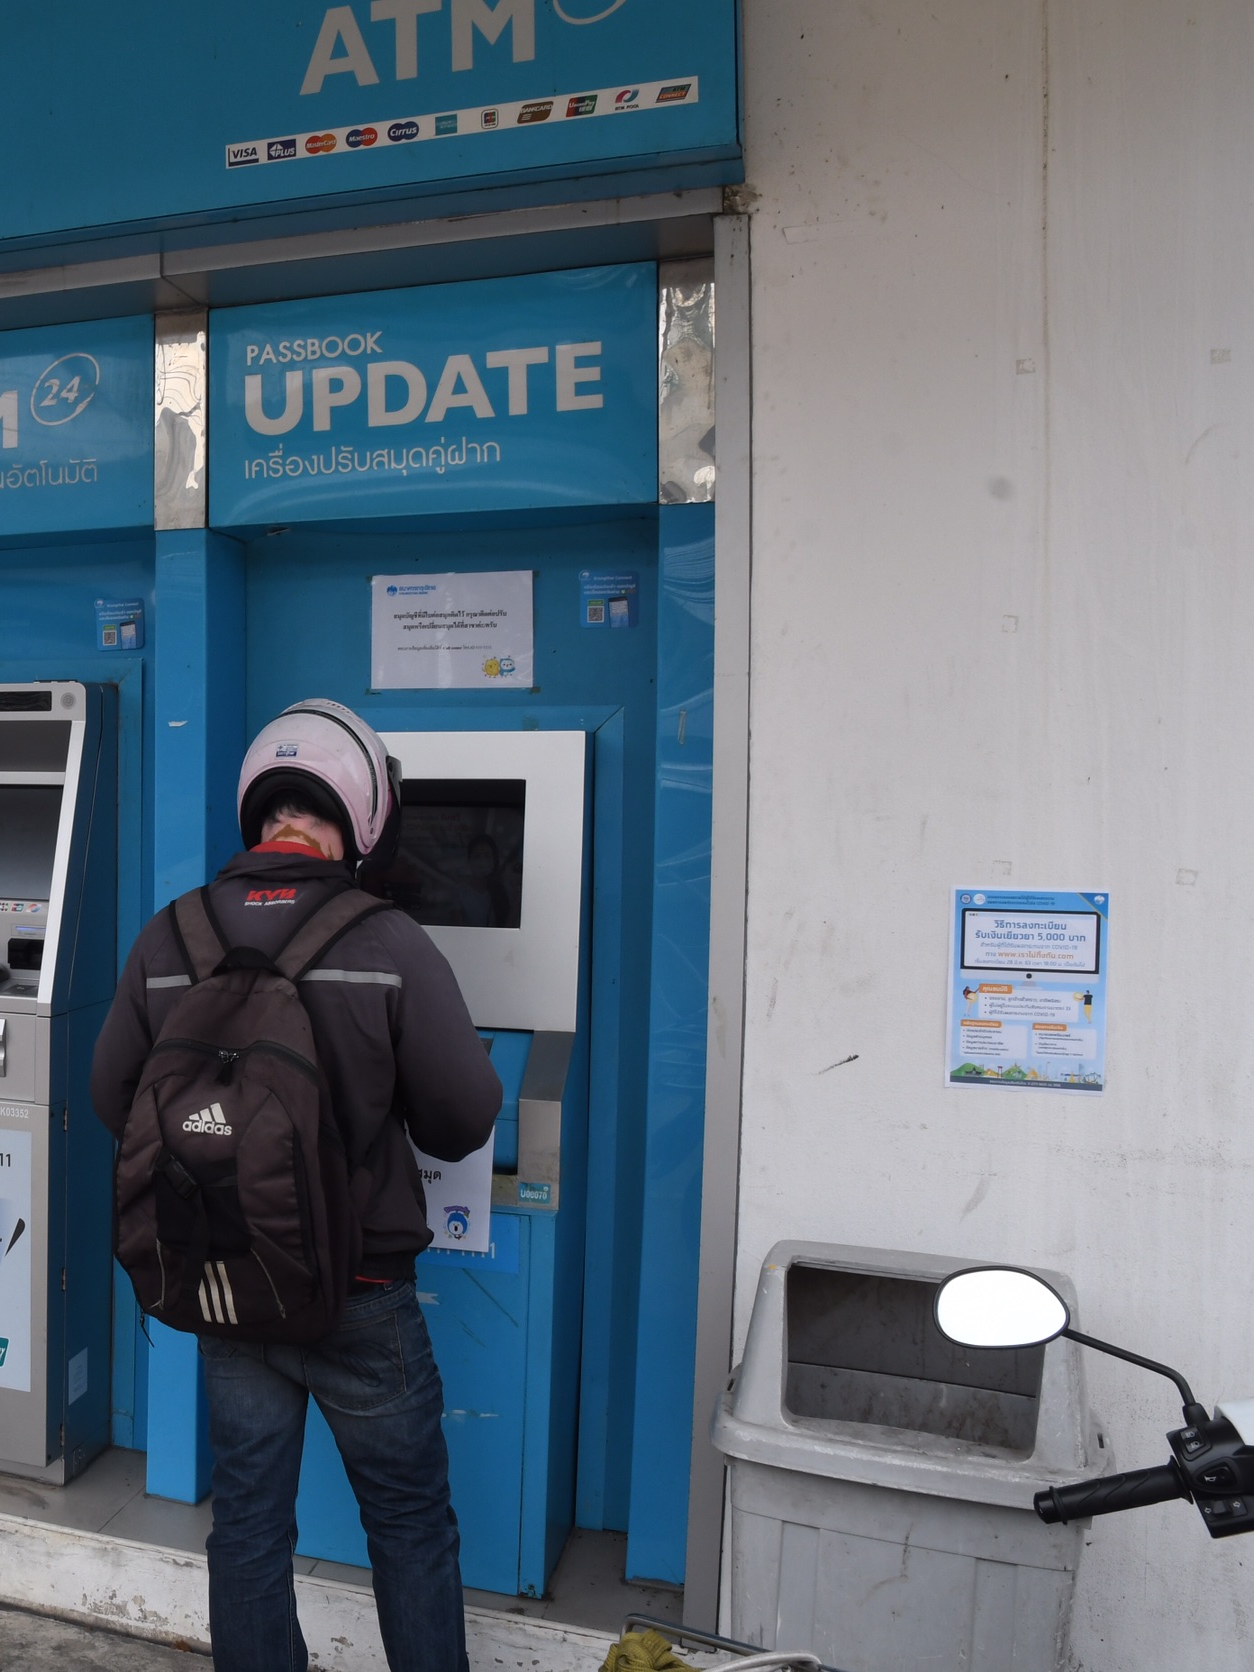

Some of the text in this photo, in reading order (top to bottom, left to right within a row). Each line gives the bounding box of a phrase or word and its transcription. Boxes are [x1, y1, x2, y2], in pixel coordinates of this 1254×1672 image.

[299, 0, 535, 95] ATM
[348, 132, 375, 142] Maestro
[389, 126, 417, 137] Cirrus
[306, 139, 337, 149] MasterCard
[232, 147, 258, 159] VISA
[275, 148, 295, 158] PLUS
[246, 331, 383, 366] PASSBOOK
[38, 376, 81, 407] 24
[244, 341, 604, 436] UPDATE
[245, 437, 501, 479] เครื่องปรับสมุดคู่ฝาก
[994, 919, 1067, 931] วิธีการลงทะเบียน
[0, 1106, 29, 1119] K03352
[182, 1119, 232, 1136] adidas
